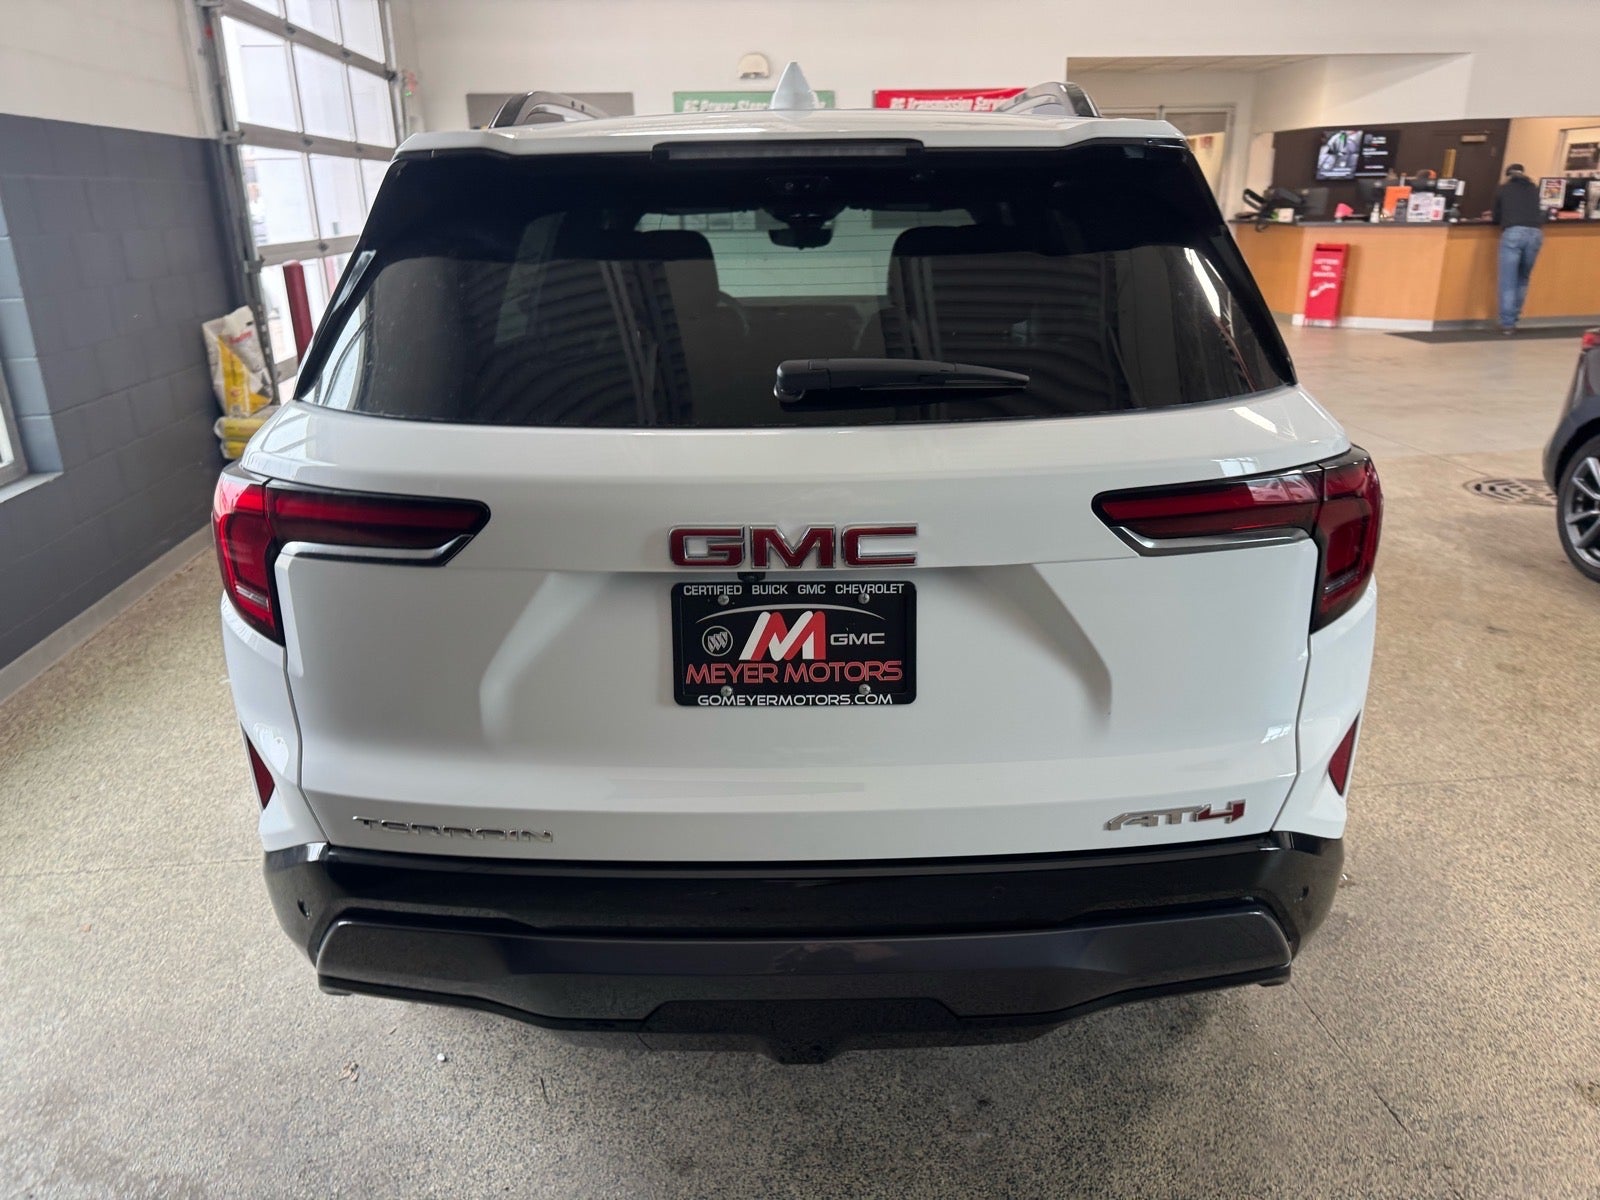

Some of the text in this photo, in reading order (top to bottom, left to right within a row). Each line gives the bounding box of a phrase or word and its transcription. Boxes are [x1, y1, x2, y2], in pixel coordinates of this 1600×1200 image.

[669, 524, 918, 569] GMC
[683, 583, 905, 596] CERTIFIED BUICK GMC CHEVROLET
[830, 632, 886, 646] GMC
[685, 660, 903, 685] MEYER MOTORS
[697, 693, 894, 706] GOMEYERMOTORS.COM
[1103, 799, 1246, 831] AT4
[352, 815, 553, 843] TERRAIN
